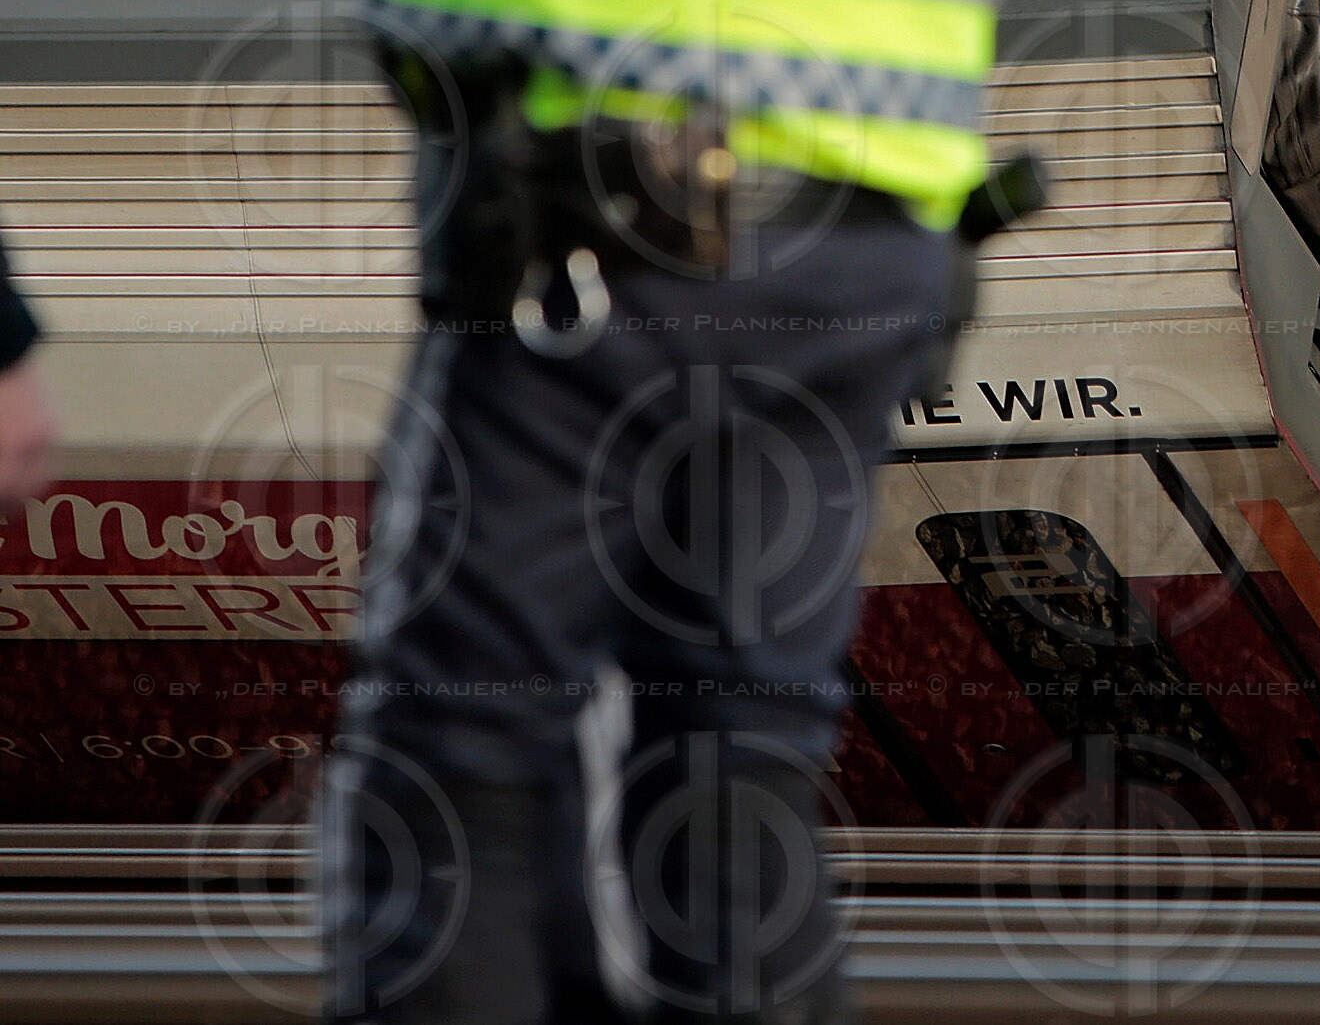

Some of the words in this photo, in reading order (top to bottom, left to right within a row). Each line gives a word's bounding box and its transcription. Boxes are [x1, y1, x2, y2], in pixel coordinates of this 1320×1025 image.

[900, 383, 962, 426] IE
[975, 377, 1143, 422] WIR.
[24, 493, 366, 577] Morg
